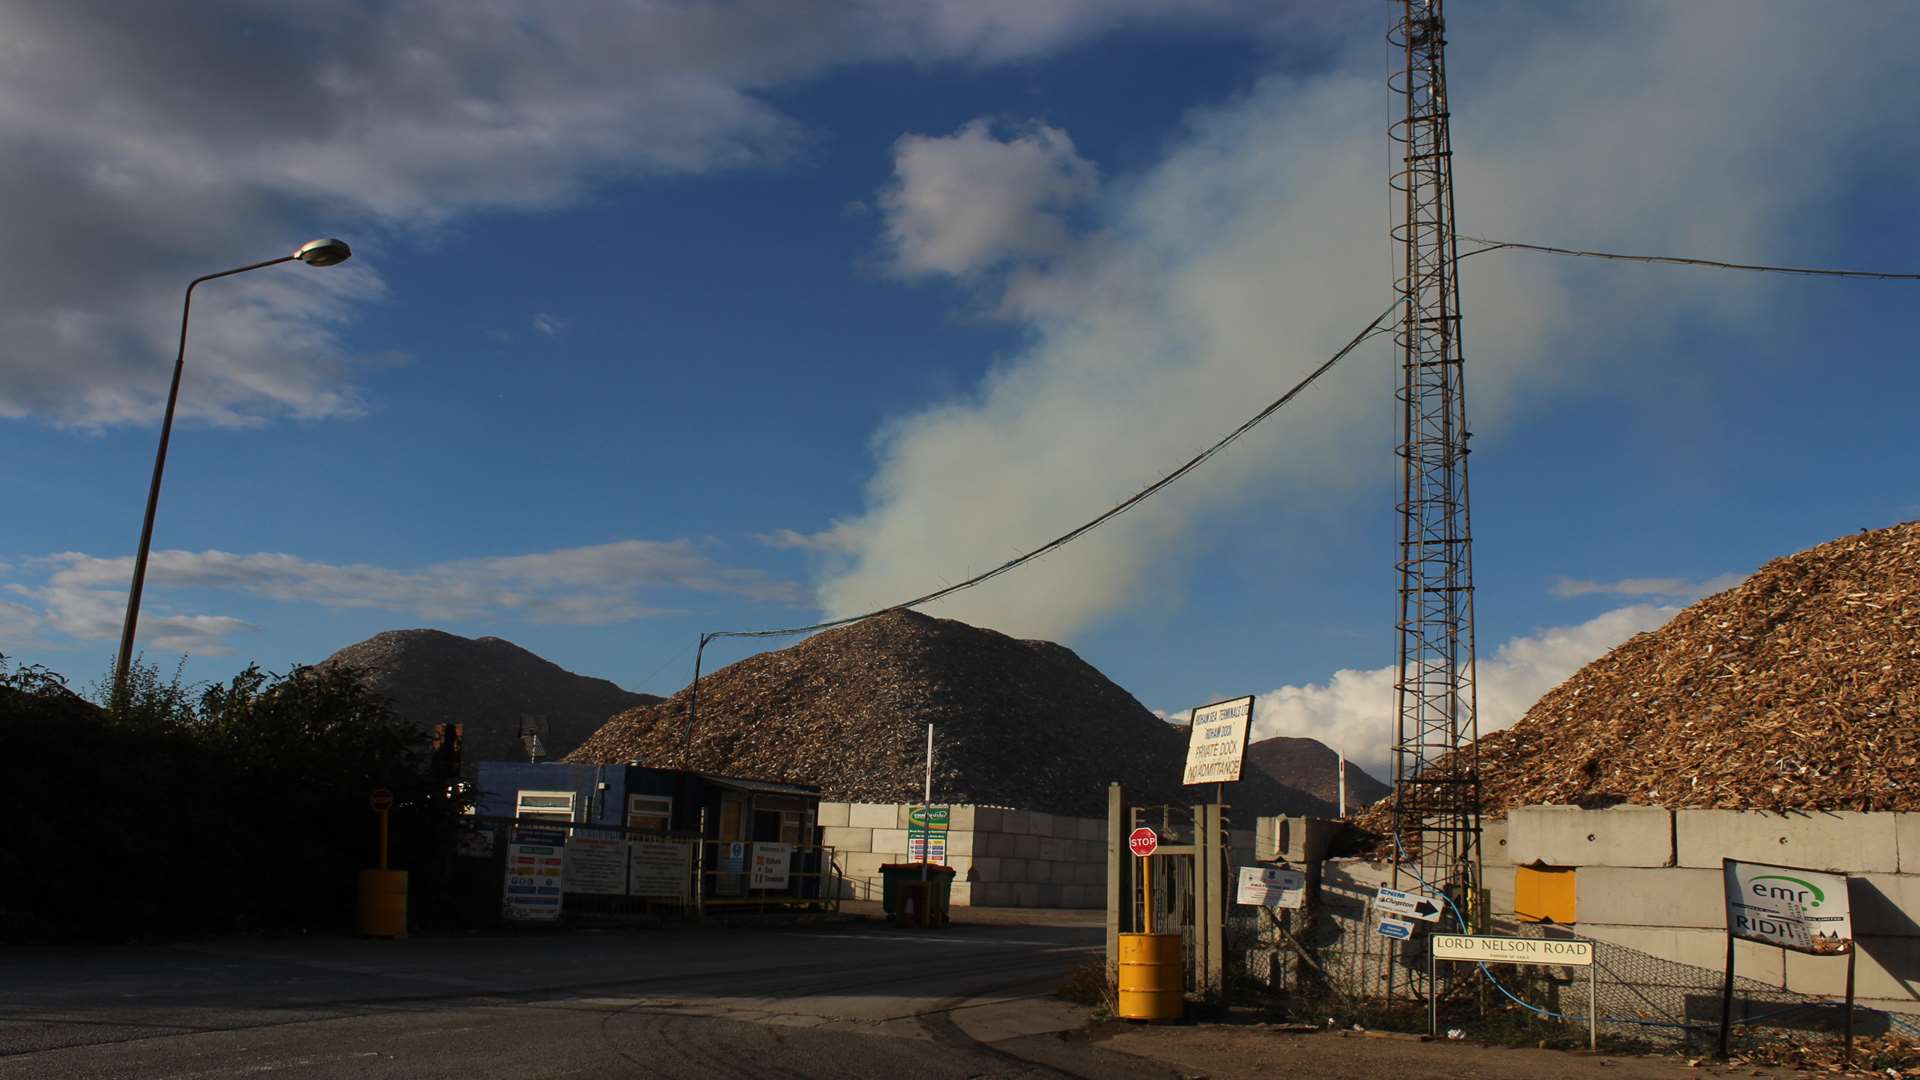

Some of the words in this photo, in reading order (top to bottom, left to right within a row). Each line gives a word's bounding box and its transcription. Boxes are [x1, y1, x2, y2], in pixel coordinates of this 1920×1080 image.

[1195, 743, 1219, 758] PRIVATE
[1219, 740, 1237, 756] DOCK
[1188, 765, 1198, 779] NO
[1198, 760, 1240, 777] ADMITTANCE
[1131, 837, 1155, 847] STOP
[1752, 883, 1808, 903] emr
[1437, 937, 1474, 949] LORD
[1481, 940, 1536, 953] NELSON
[1544, 942, 1587, 955] ROAD
